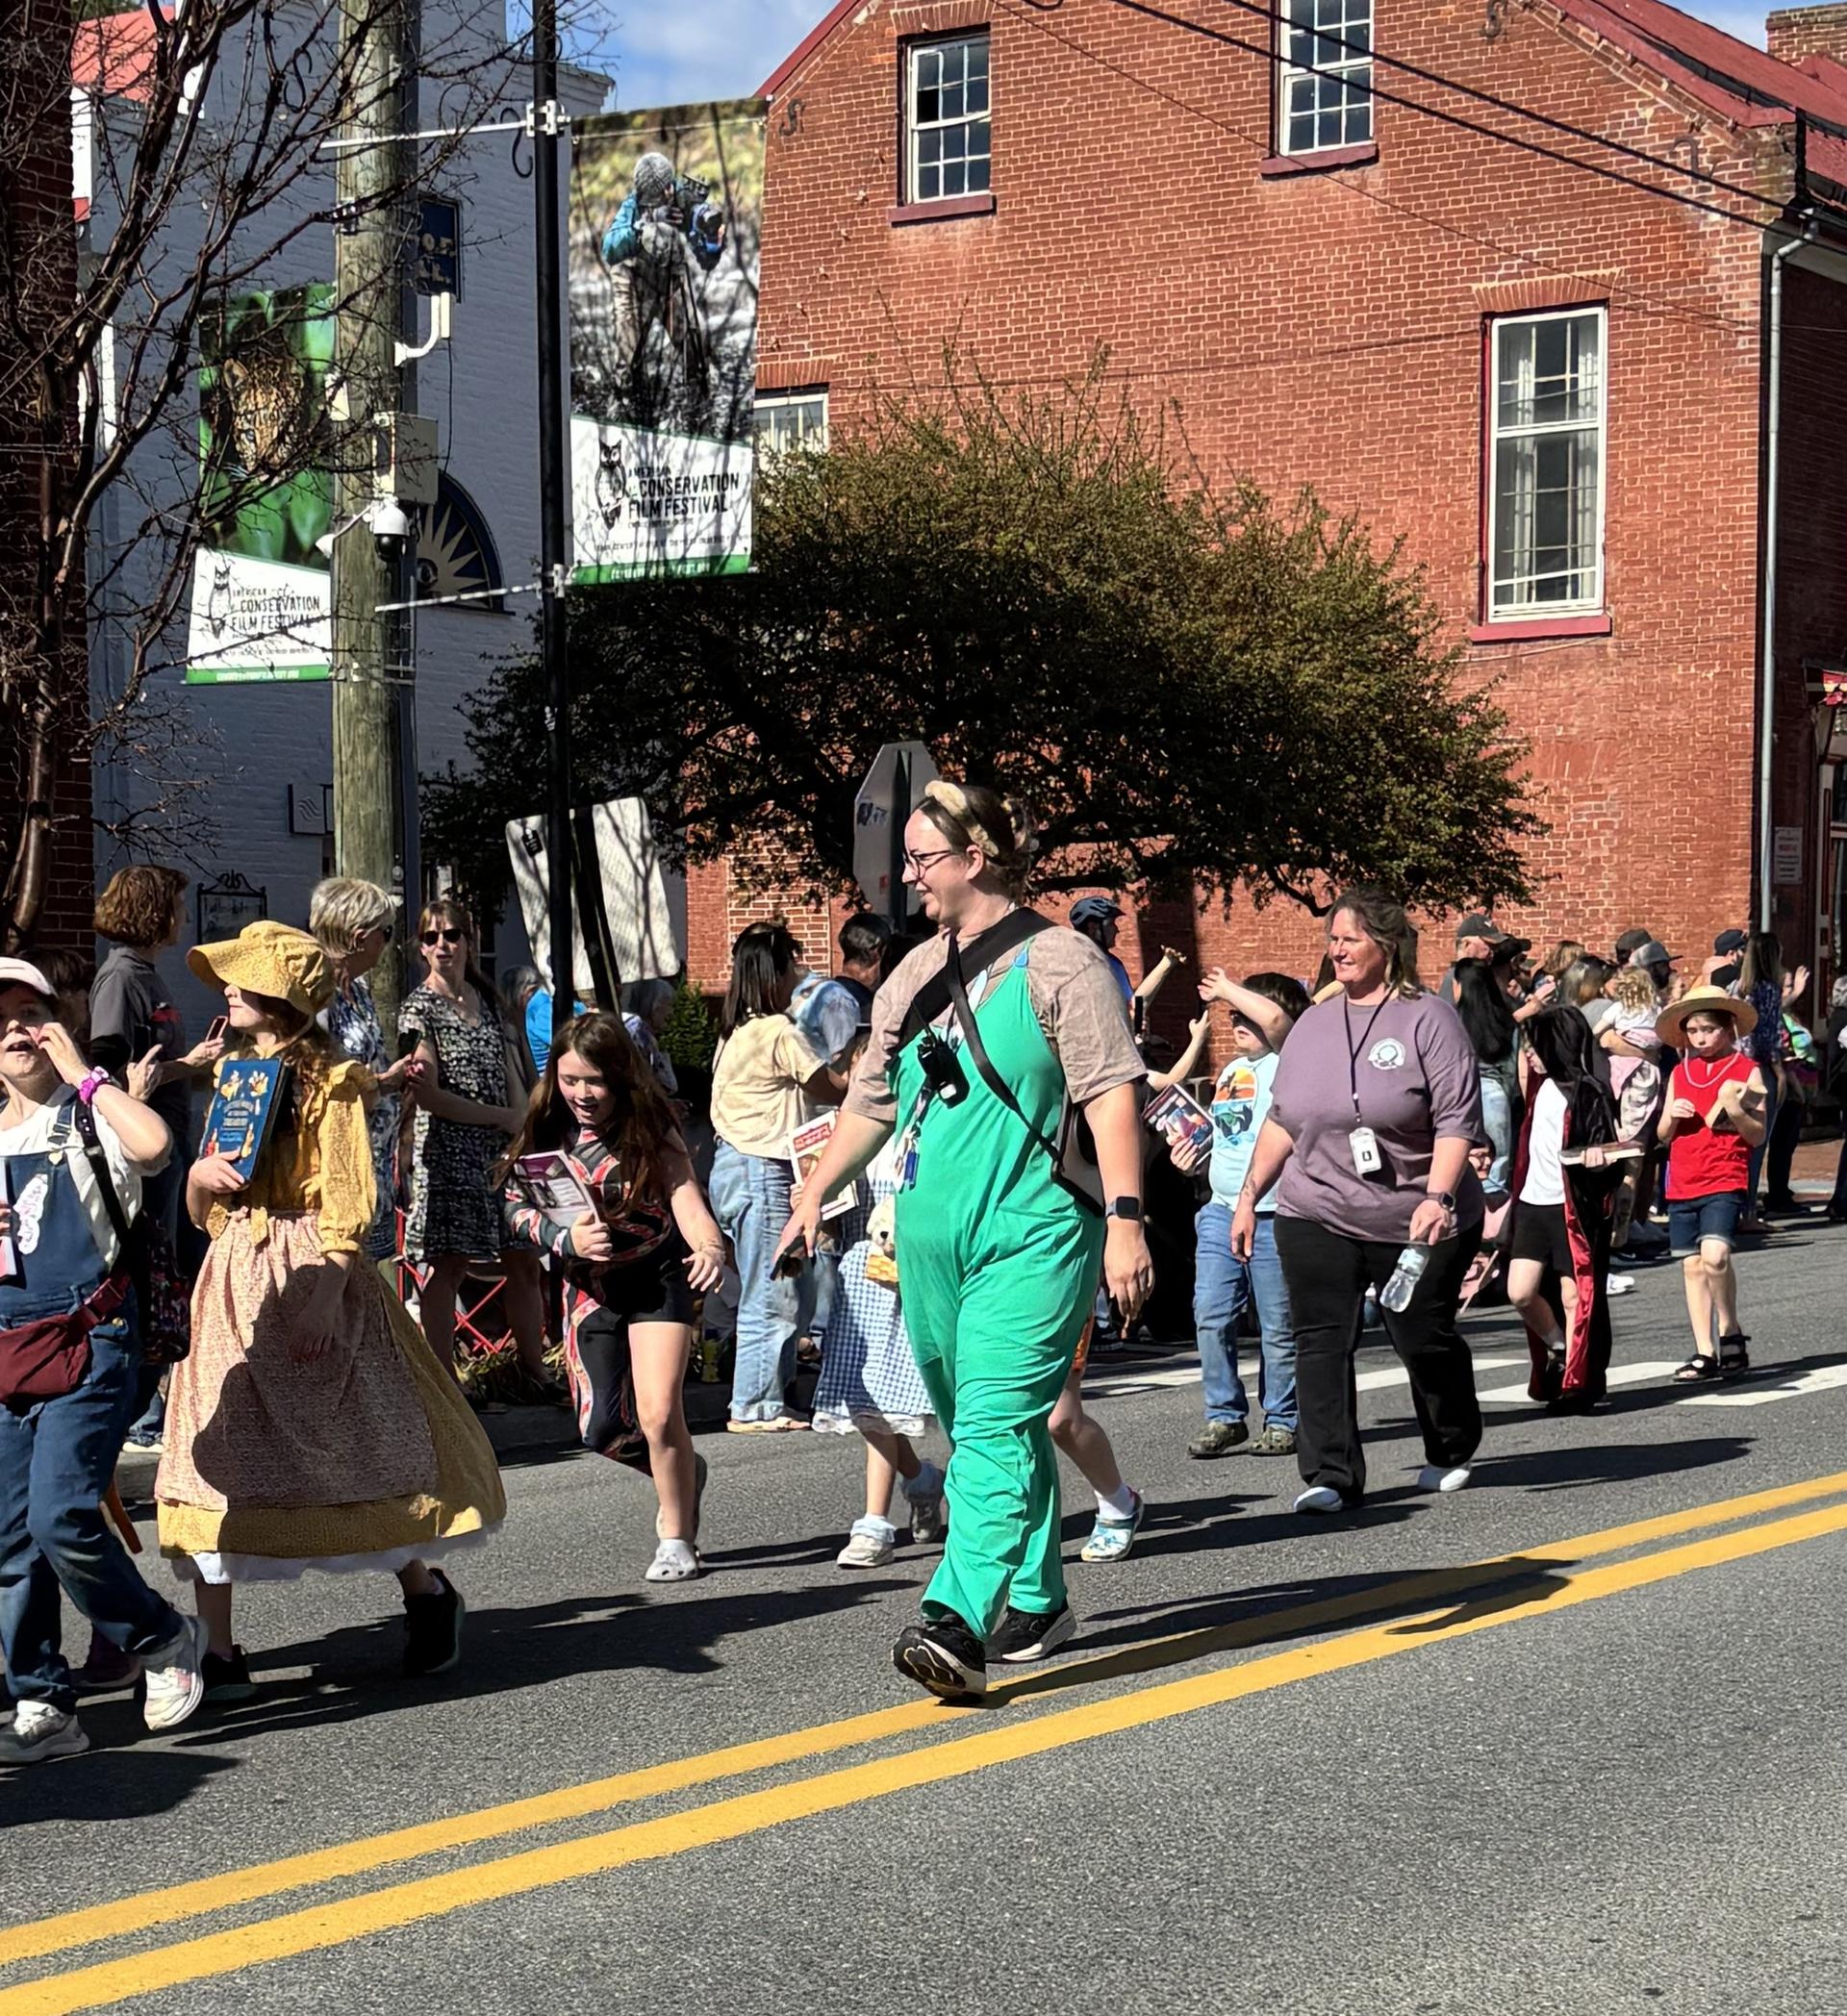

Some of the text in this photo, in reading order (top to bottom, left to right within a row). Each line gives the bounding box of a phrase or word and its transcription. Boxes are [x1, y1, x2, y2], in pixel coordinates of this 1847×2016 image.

[640, 472, 740, 498] CONSERVATION
[628, 494, 728, 519] FILM FESTIVAL
[240, 595, 321, 614] CONSERVATION
[232, 616, 258, 631] FILM
